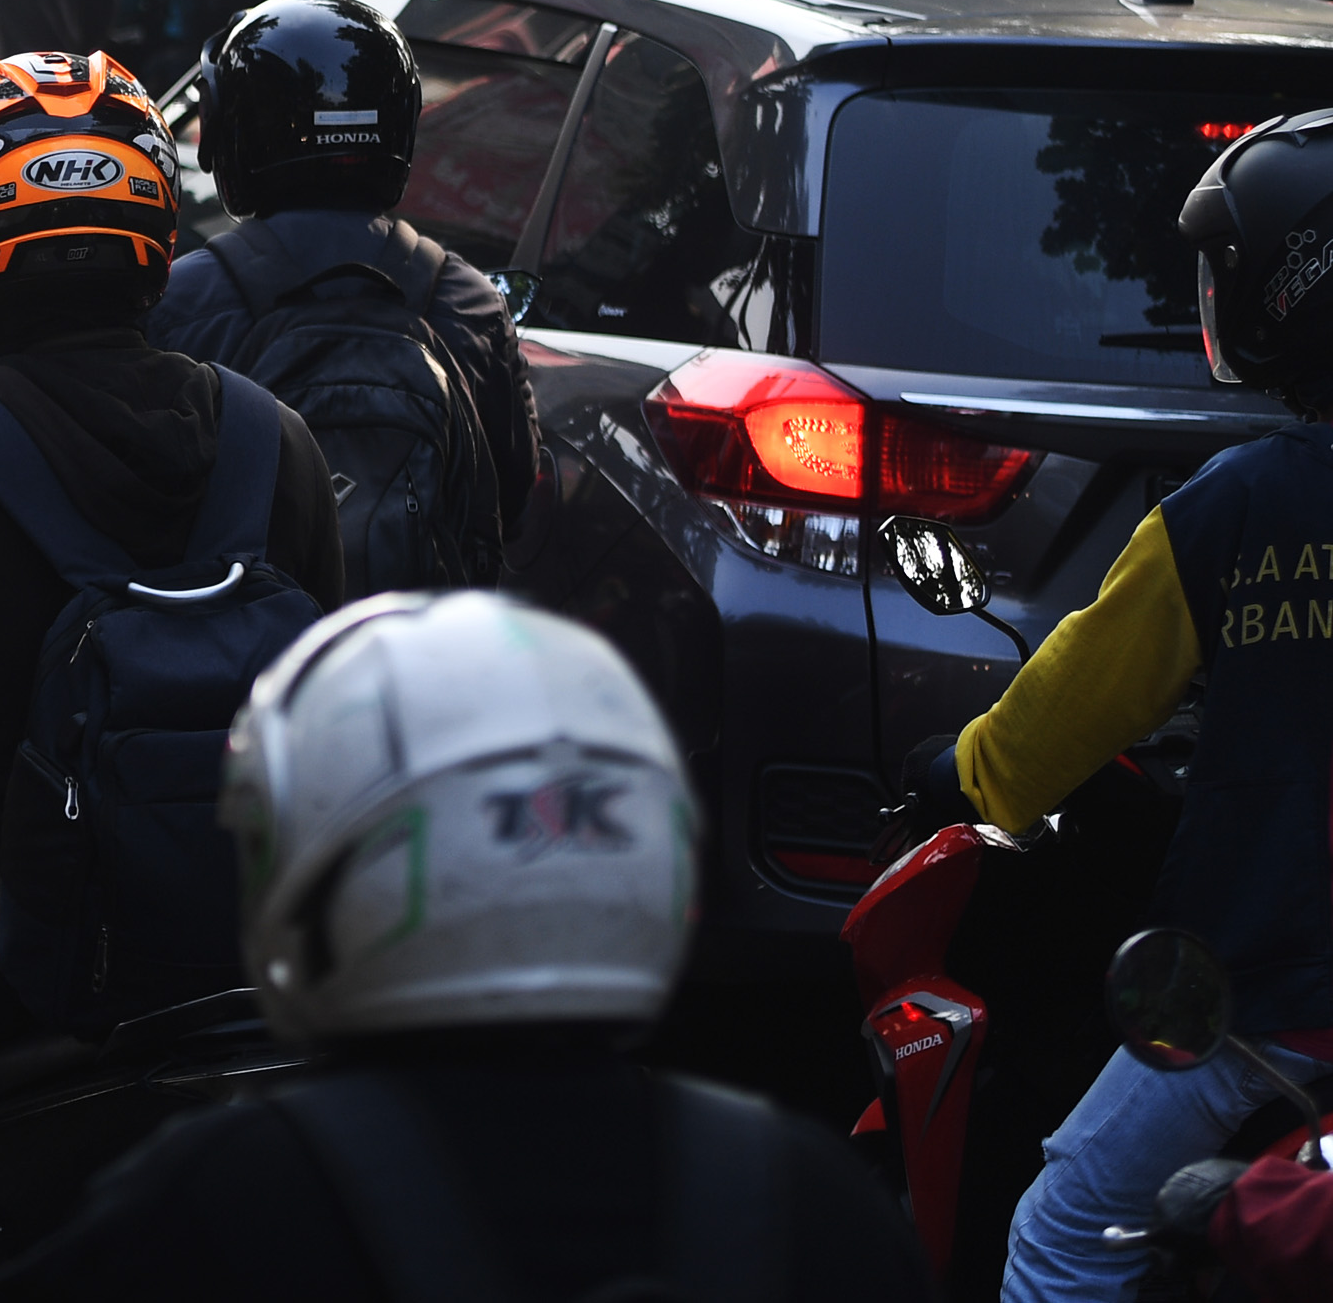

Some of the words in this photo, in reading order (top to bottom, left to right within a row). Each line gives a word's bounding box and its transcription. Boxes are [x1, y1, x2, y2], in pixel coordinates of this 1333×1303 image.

[316, 132, 381, 145] HONDA
[34, 159, 112, 183] NHK
[135, 178, 158, 190] WORLD
[135, 184, 158, 196] RACE
[67, 246, 89, 261] DOT
[895, 1033, 944, 1060] HONDA
